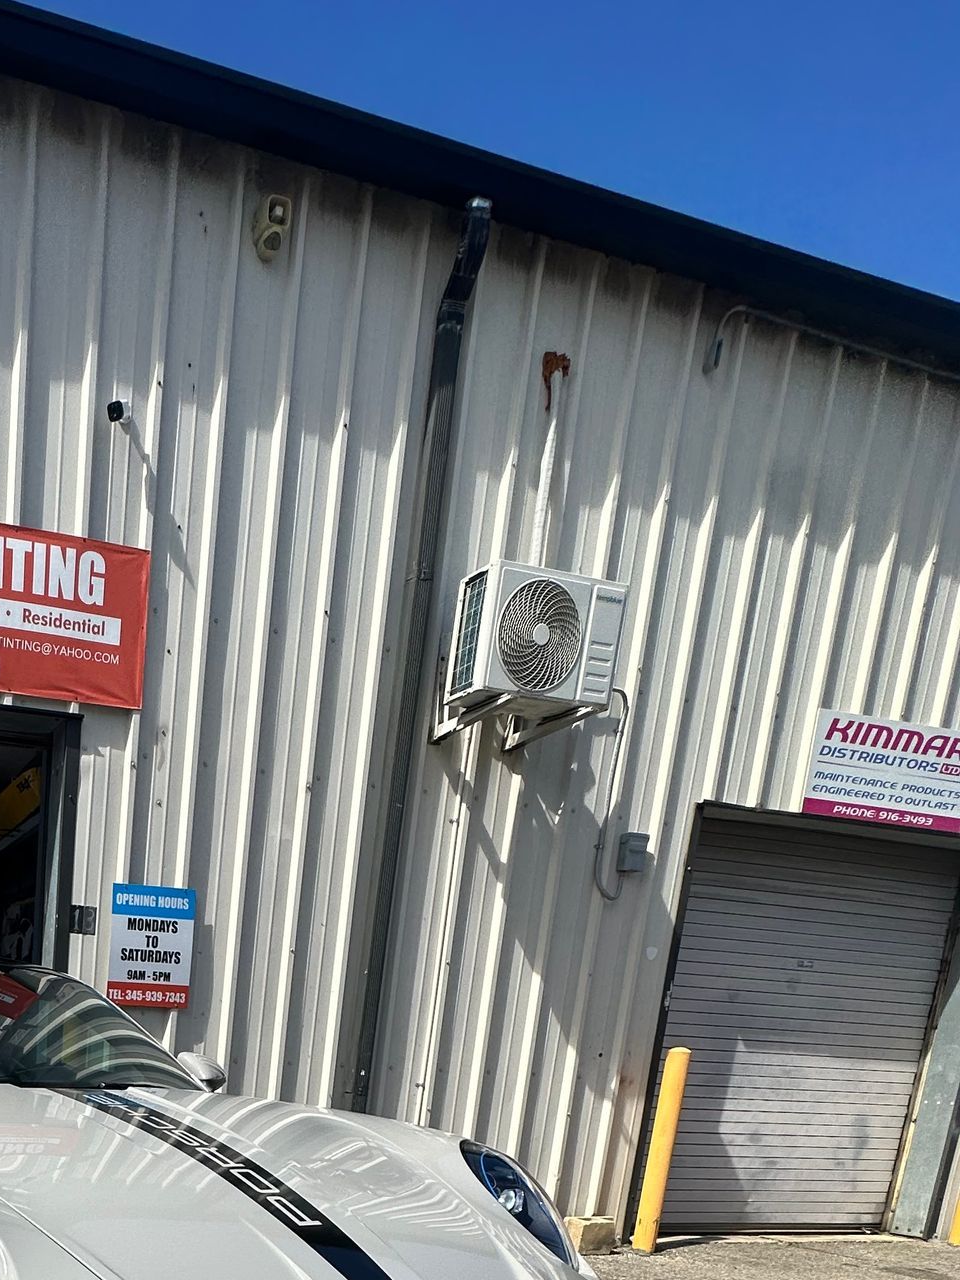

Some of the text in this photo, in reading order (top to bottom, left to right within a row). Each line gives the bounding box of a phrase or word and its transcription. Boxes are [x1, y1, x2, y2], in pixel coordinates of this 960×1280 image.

[23, 608, 105, 636] Residential
[819, 745, 960, 775] DISTRIBUTORS LTD
[814, 770, 960, 799] MAINTENANCE PRODUCTS
[812, 784, 957, 811] ENGINEERED TO OUTLAST
[878, 811, 933, 826] 916-3493
[116, 892, 189, 910] OPENING HOURS
[127, 917, 178, 934] MONDAYS
[145, 935, 159, 948] TO
[120, 947, 181, 964] SATURDAYS
[127, 969, 146, 980] 9AM
[152, 971, 171, 982] 5PM
[108, 989, 185, 1004] TEL: 345-939-7343
[83, 1093, 322, 1228] PORSCHE
